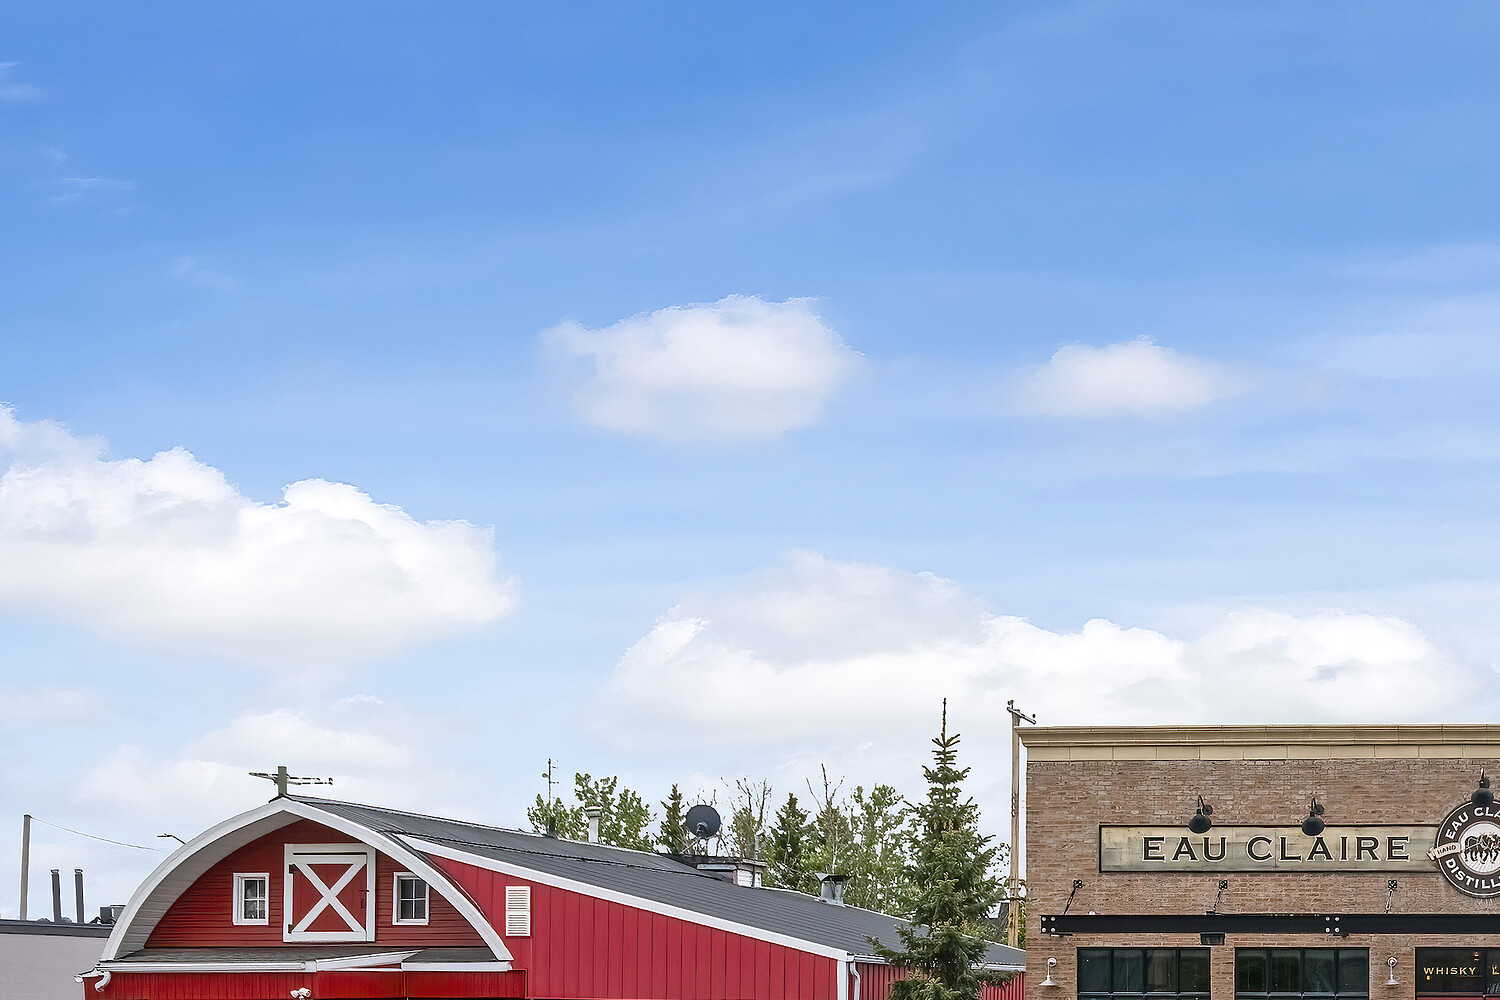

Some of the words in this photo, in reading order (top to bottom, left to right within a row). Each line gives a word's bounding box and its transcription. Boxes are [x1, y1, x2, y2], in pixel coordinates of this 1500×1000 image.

[1445, 812, 1469, 840] EAU
[1142, 836, 1229, 863] EAU
[1245, 835, 1410, 864] CLAIRE
[1436, 844, 1457, 855] HAND
[1423, 966, 1477, 975] WHISKY
